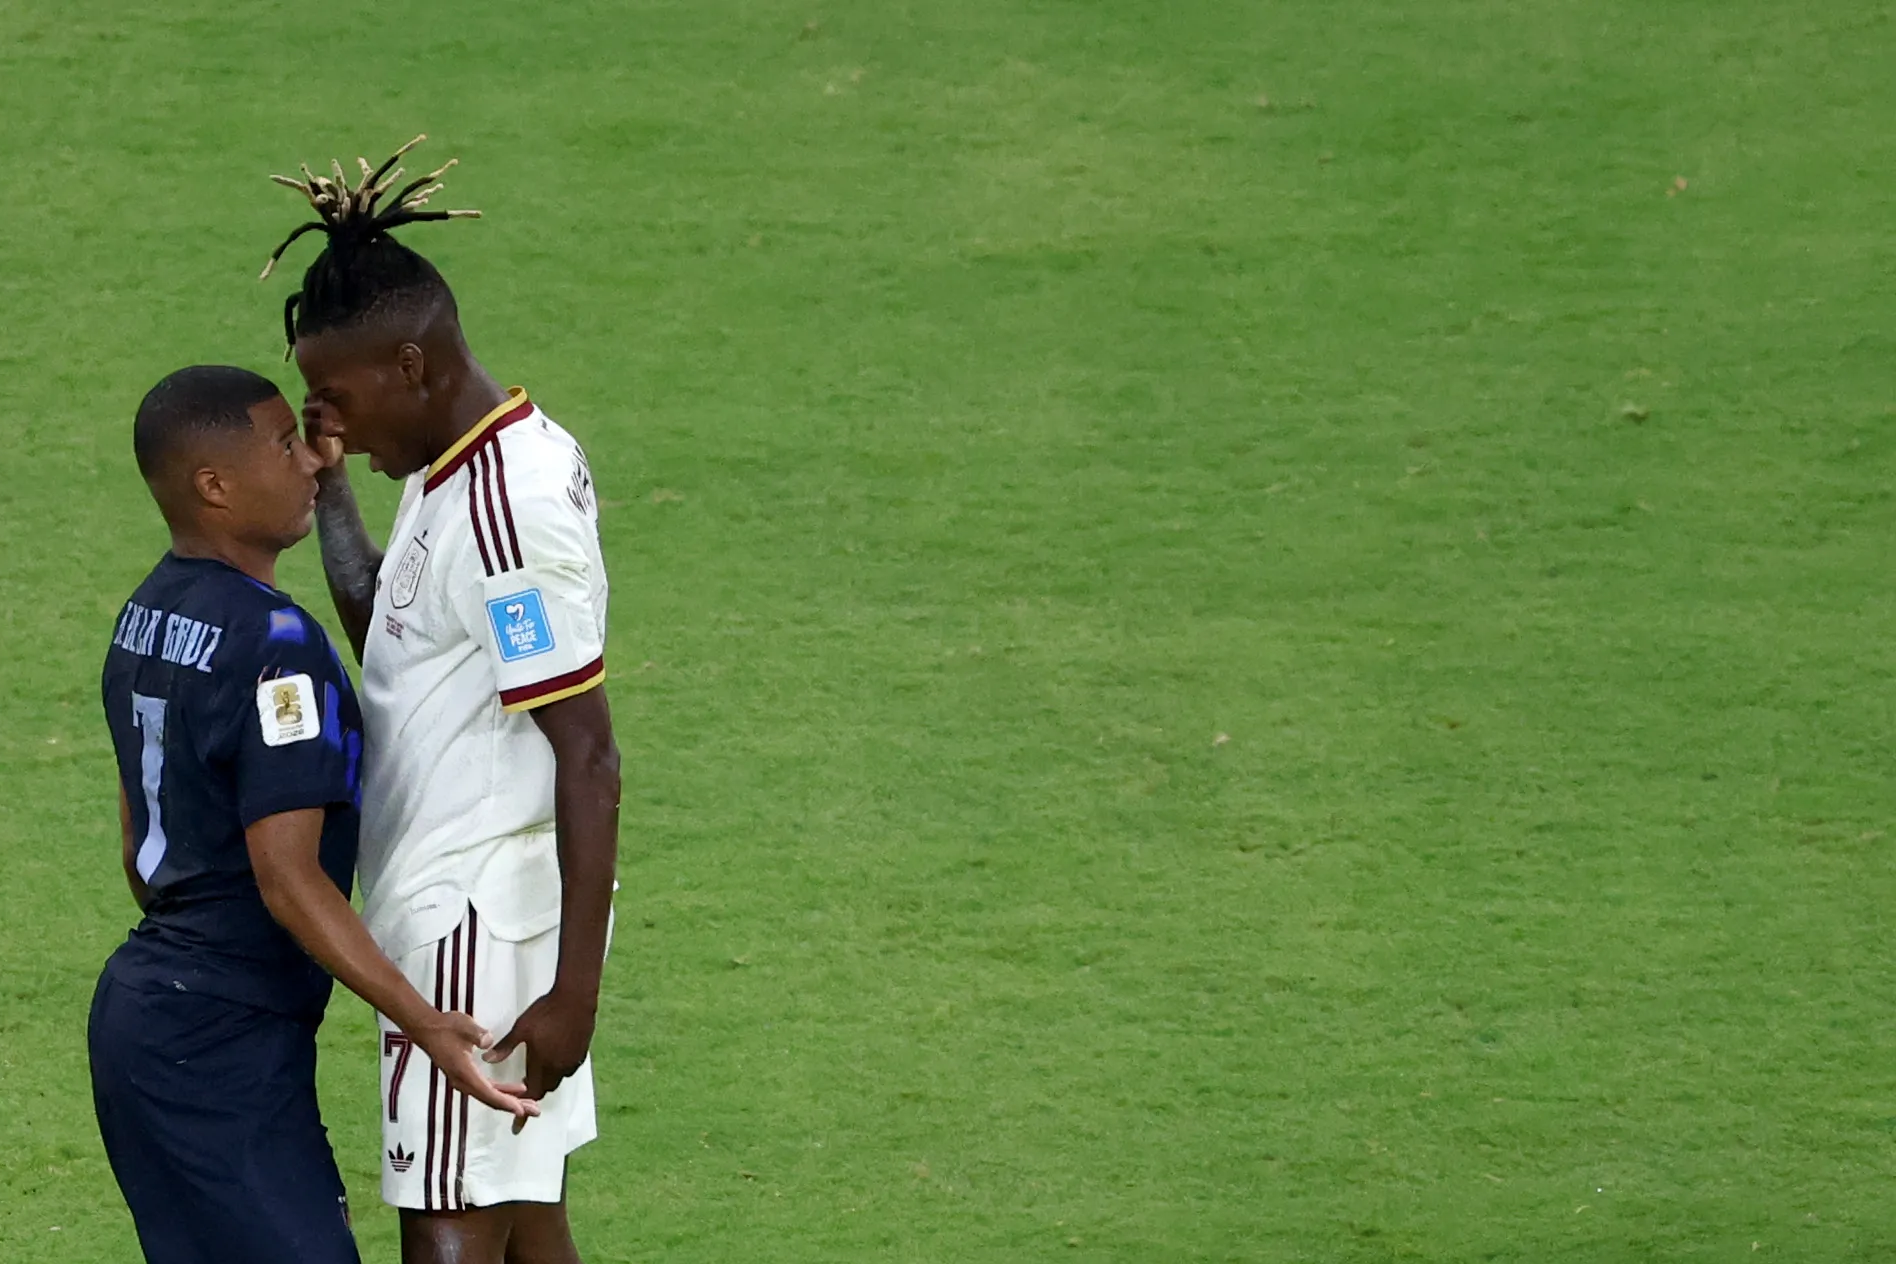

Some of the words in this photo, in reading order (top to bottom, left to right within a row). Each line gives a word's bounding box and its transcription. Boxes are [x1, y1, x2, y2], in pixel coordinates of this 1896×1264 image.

[161, 612, 223, 673] CRUZ
[510, 629, 538, 647] PEACE
[131, 690, 167, 885] 7
[384, 1031, 412, 1123] 7
